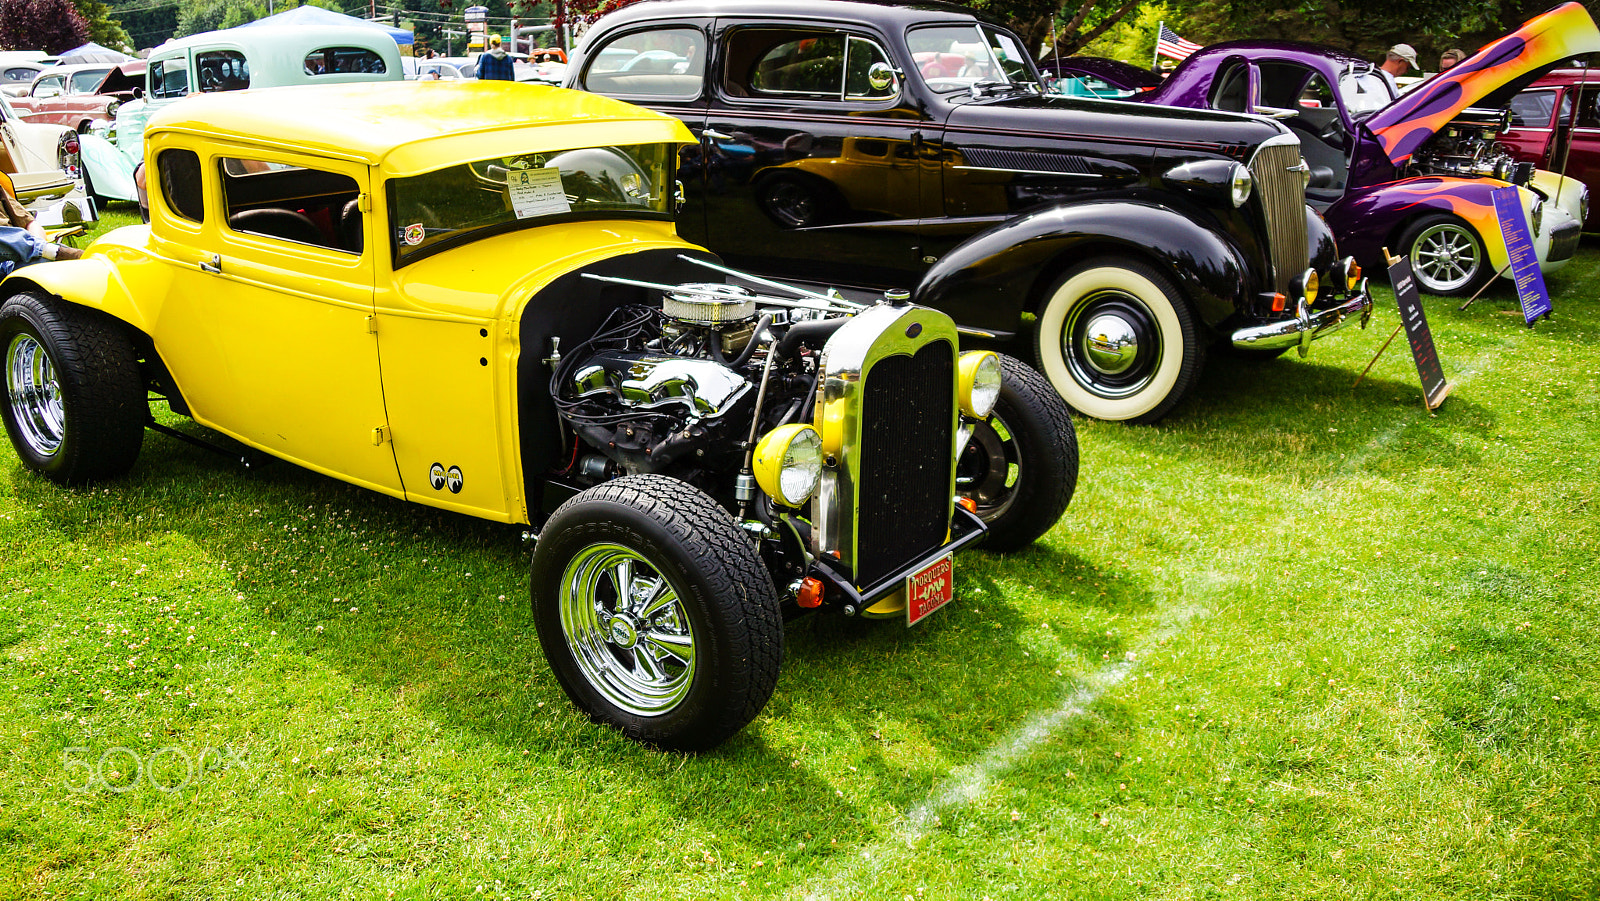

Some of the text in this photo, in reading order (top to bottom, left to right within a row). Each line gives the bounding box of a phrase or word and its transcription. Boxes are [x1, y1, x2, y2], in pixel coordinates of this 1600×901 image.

[433, 470, 460, 480] MOON
[911, 561, 950, 601] TORQUERS
[918, 591, 945, 616] TACOMA
